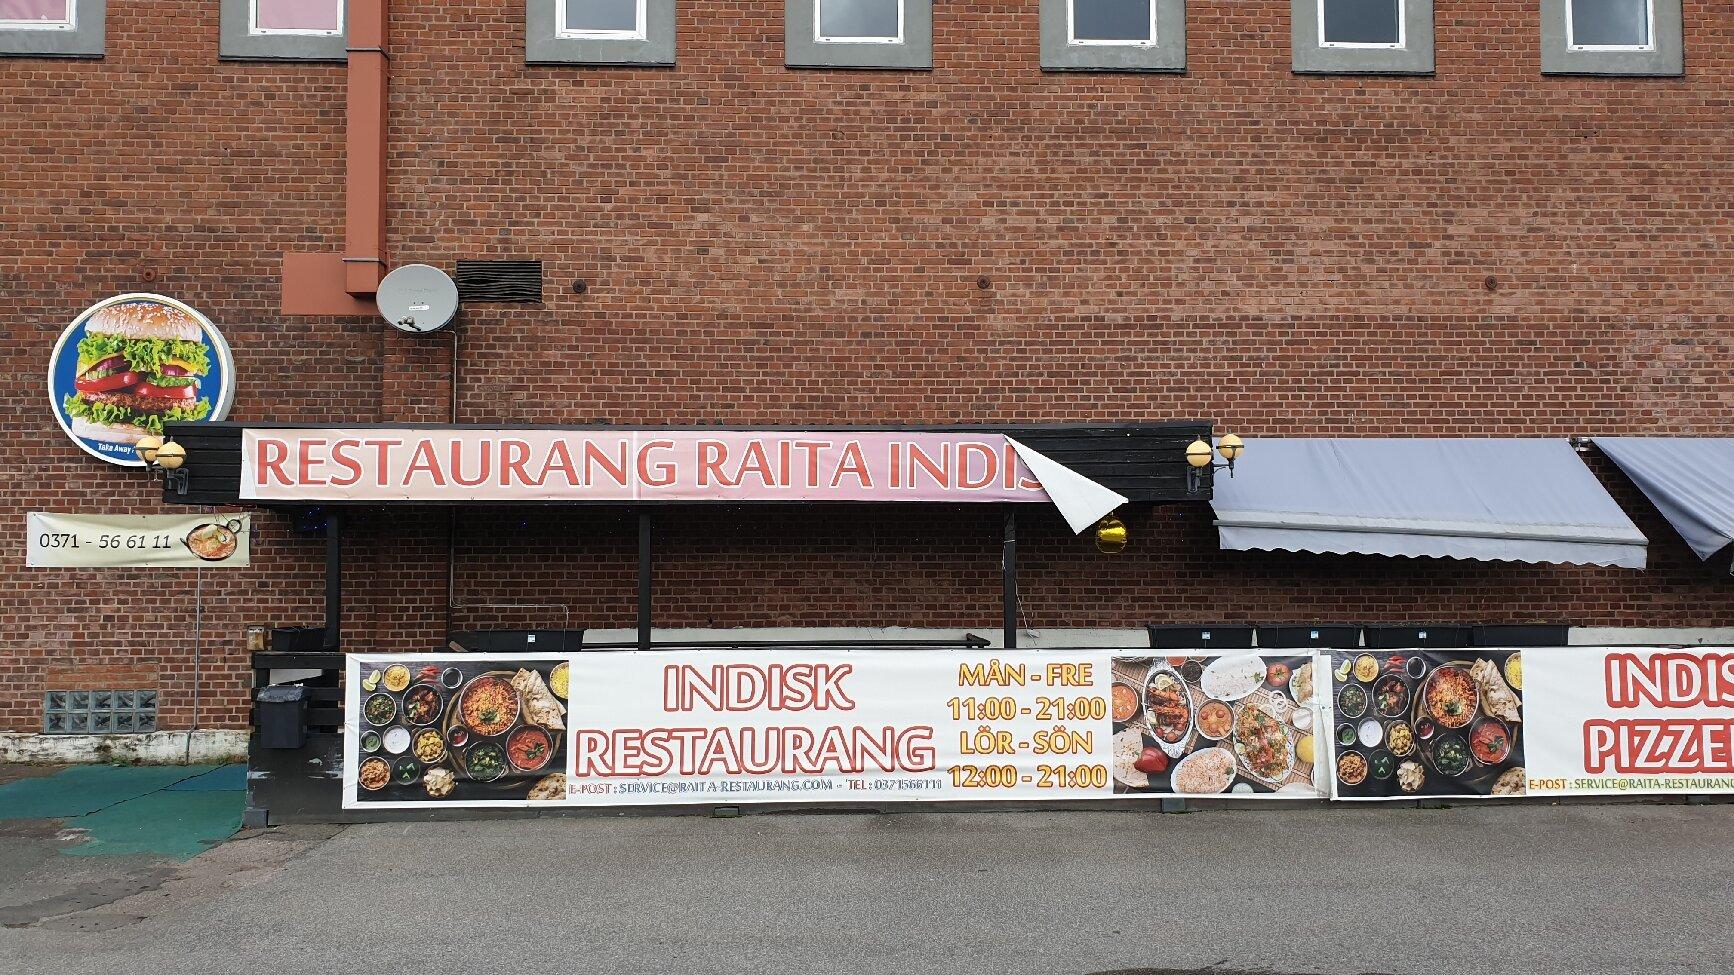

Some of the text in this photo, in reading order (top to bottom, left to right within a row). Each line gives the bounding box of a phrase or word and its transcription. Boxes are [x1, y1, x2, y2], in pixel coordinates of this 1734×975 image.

[98, 443, 113, 451] Take
[114, 445, 132, 454] Away
[255, 438, 678, 488] RESTAURANG
[696, 439, 874, 489] RAITA
[39, 533, 80, 548] 0371
[98, 534, 121, 549] 56
[126, 534, 146, 549] 61
[152, 534, 172, 549] 11
[958, 659, 1025, 686] MÅN
[1046, 663, 1094, 686] FRE
[663, 664, 856, 712] INDISK
[947, 697, 1017, 720] 11:00
[1036, 697, 1106, 720] 21:00
[575, 726, 936, 777] RESTAURANG
[960, 725, 1015, 754] LÖR
[1033, 725, 1093, 754] SÖN
[1583, 718, 1734, 774] PIZZE
[947, 765, 1017, 788] 12:00
[1037, 765, 1108, 788] 21:00
